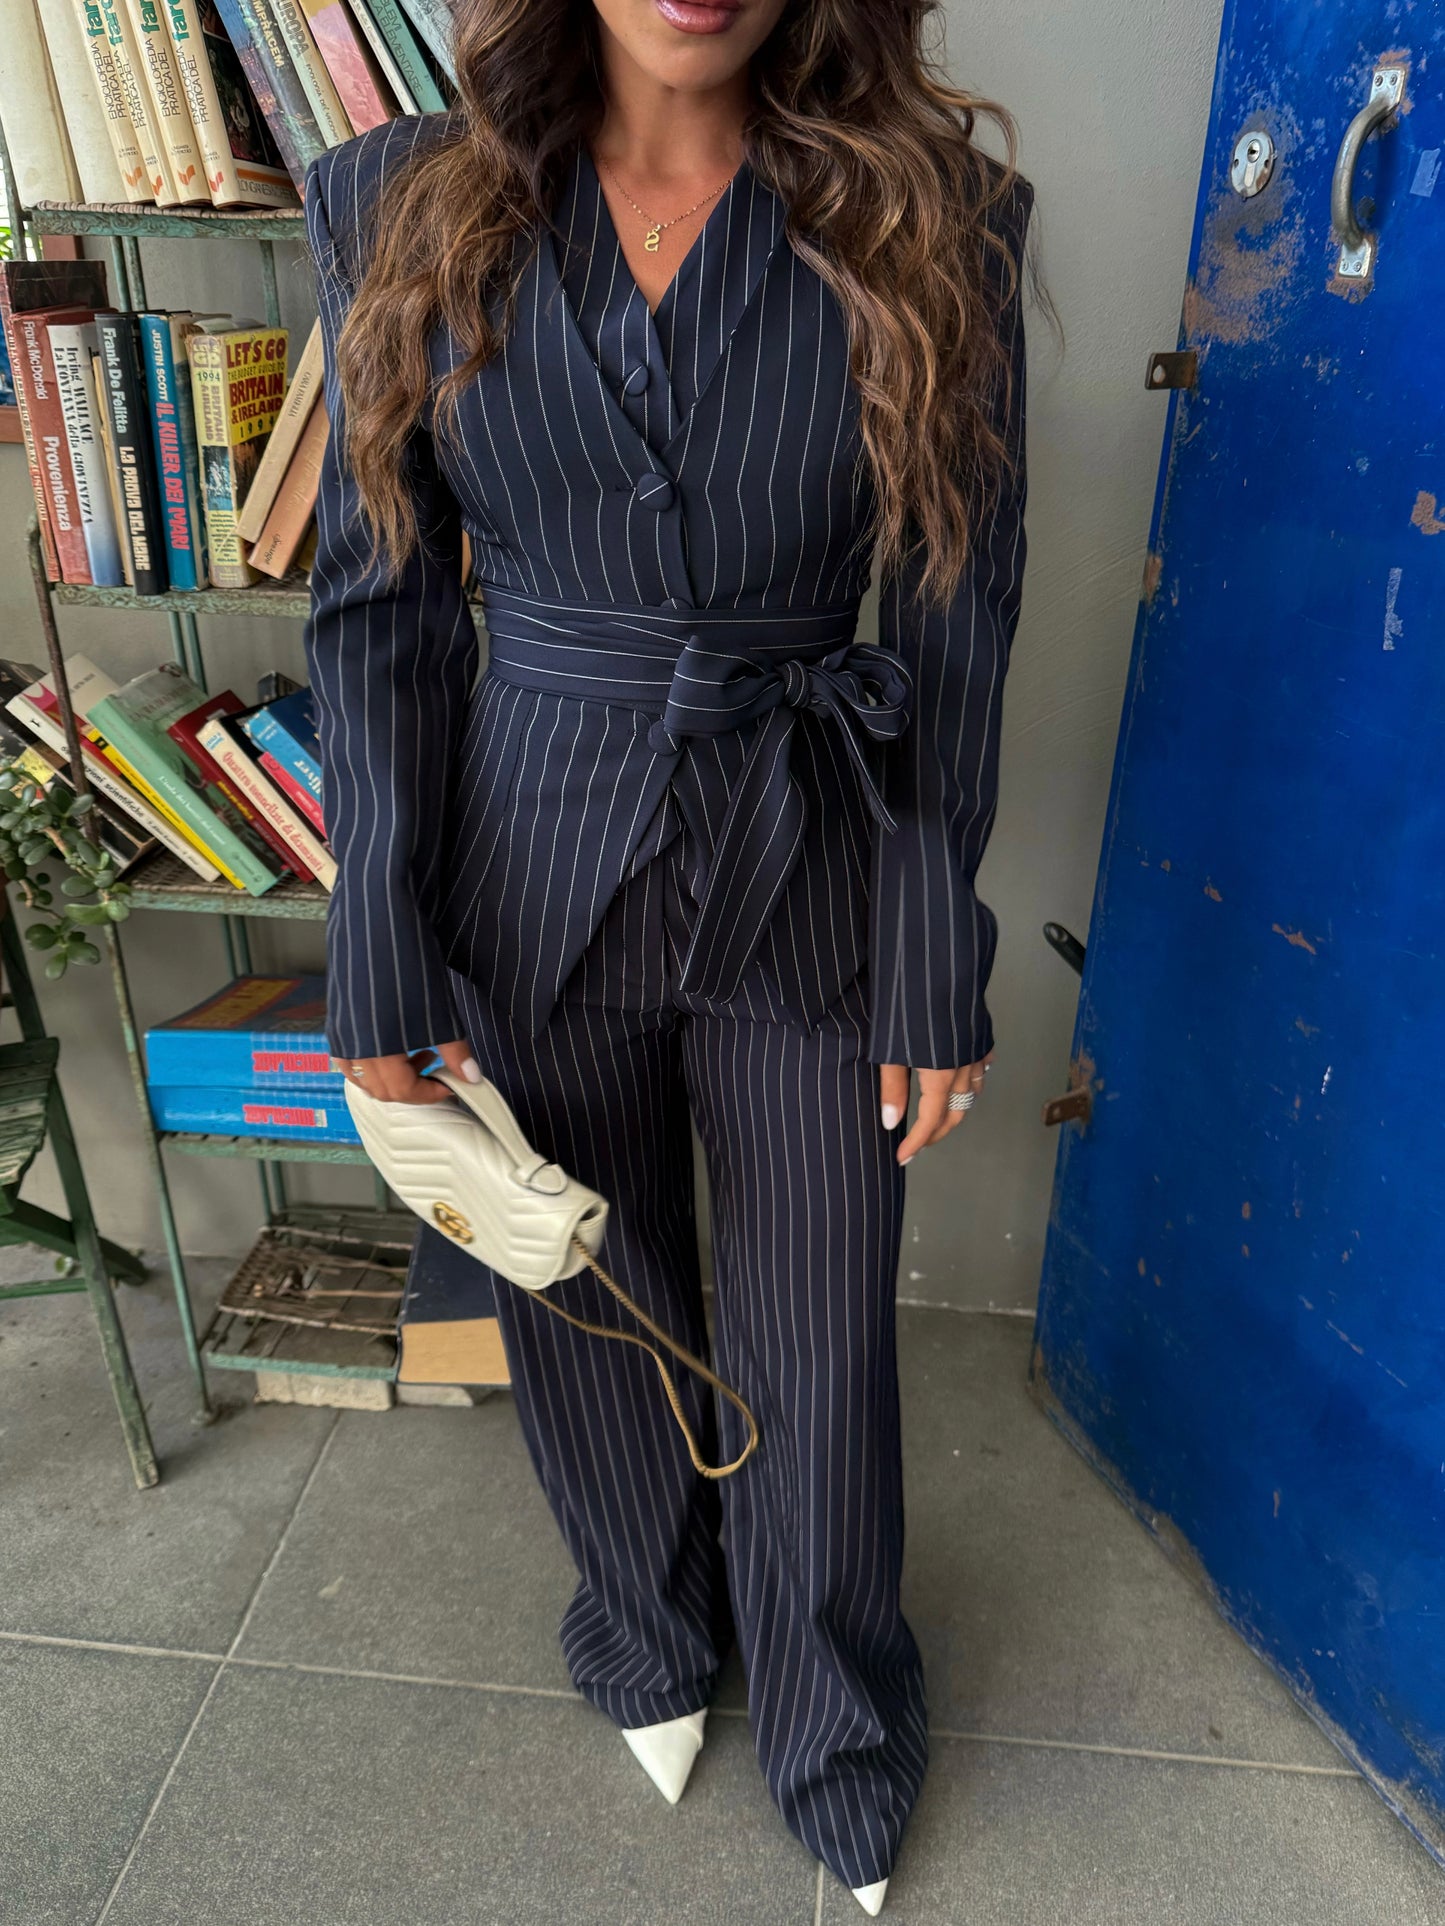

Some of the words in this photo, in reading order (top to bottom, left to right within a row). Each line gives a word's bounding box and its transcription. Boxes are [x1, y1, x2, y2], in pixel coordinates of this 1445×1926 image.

[253, 0, 285, 68] MPRACEM
[102, 50, 116, 73] DEL
[121, 59, 135, 82] DEL
[156, 48, 170, 69] DEL
[186, 55, 200, 76] DEL
[379, 16, 422, 93] ELEMENTARE
[90, 41, 118, 120] ENCICLOPEDIA
[108, 72, 127, 119] PRATICA
[145, 38, 170, 117] ENCICLOPEDIA
[161, 69, 181, 116] PRATICA
[175, 45, 202, 125] ENCICLOPEDIA
[127, 82, 146, 127] PRATICA
[191, 76, 209, 123] PRATICA
[22, 320, 40, 349] Frank
[53, 346, 67, 361] La
[102, 326, 121, 368] Frank
[149, 328, 164, 367] JUSTIN
[226, 341, 263, 368] LET'S
[265, 337, 286, 361] GO
[65, 345, 84, 382] Irving
[108, 368, 124, 389] De
[197, 370, 221, 382] 1994
[228, 371, 238, 381] THE
[238, 366, 256, 379] BUDGET
[258, 363, 276, 374] GUIDE
[277, 362, 285, 371] TO
[56, 363, 77, 422] FONTANA
[155, 368, 169, 403] SCOTT
[229, 373, 284, 407] BRITAIN
[72, 386, 95, 446] WALLACE
[111, 390, 131, 435] Felitta
[155, 400, 175, 419] IL
[202, 392, 214, 440] IRELAND
[211, 385, 225, 442] BRITAIN
[231, 409, 238, 425] &
[239, 397, 283, 421] IRELAND
[66, 423, 82, 449] della
[156, 419, 183, 476] KILLER
[42, 434, 76, 532] Provenienza
[72, 451, 94, 525] GIOVINEZZA
[163, 475, 184, 505] DEI
[127, 509, 146, 536] DEL
[166, 505, 191, 552] MARI
[220, 750, 255, 788] Quattro
[102, 780, 146, 819] scientifiche
[247, 780, 289, 827] tonnellate
[281, 820, 297, 837] di
[288, 829, 328, 873] diamanti
[252, 1052, 330, 1073] BRICOLAGE
[243, 1104, 316, 1127] BRICOLAGE
